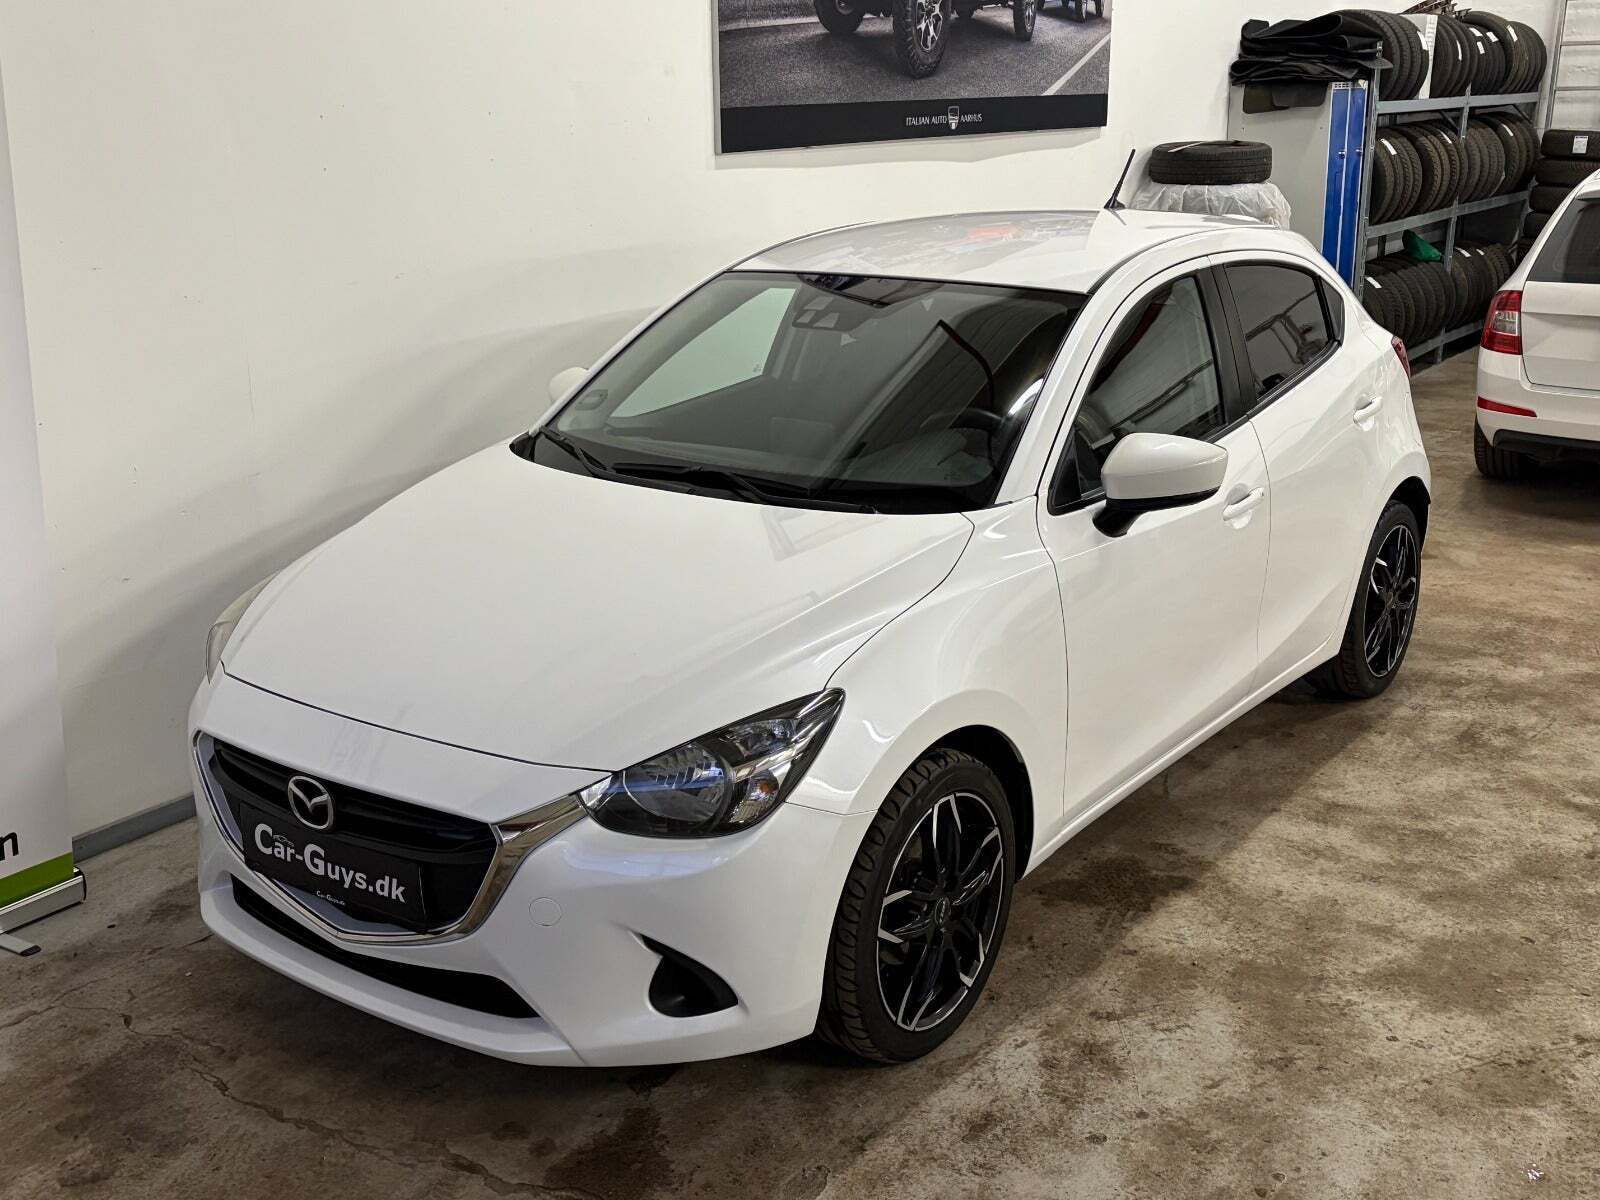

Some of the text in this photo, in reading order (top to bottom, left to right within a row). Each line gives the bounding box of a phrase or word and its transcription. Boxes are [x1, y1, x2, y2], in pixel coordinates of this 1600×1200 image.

[906, 114, 982, 126] ITALIAN AUTO AARHUS
[254, 823, 405, 903] Car-Guys.dk
